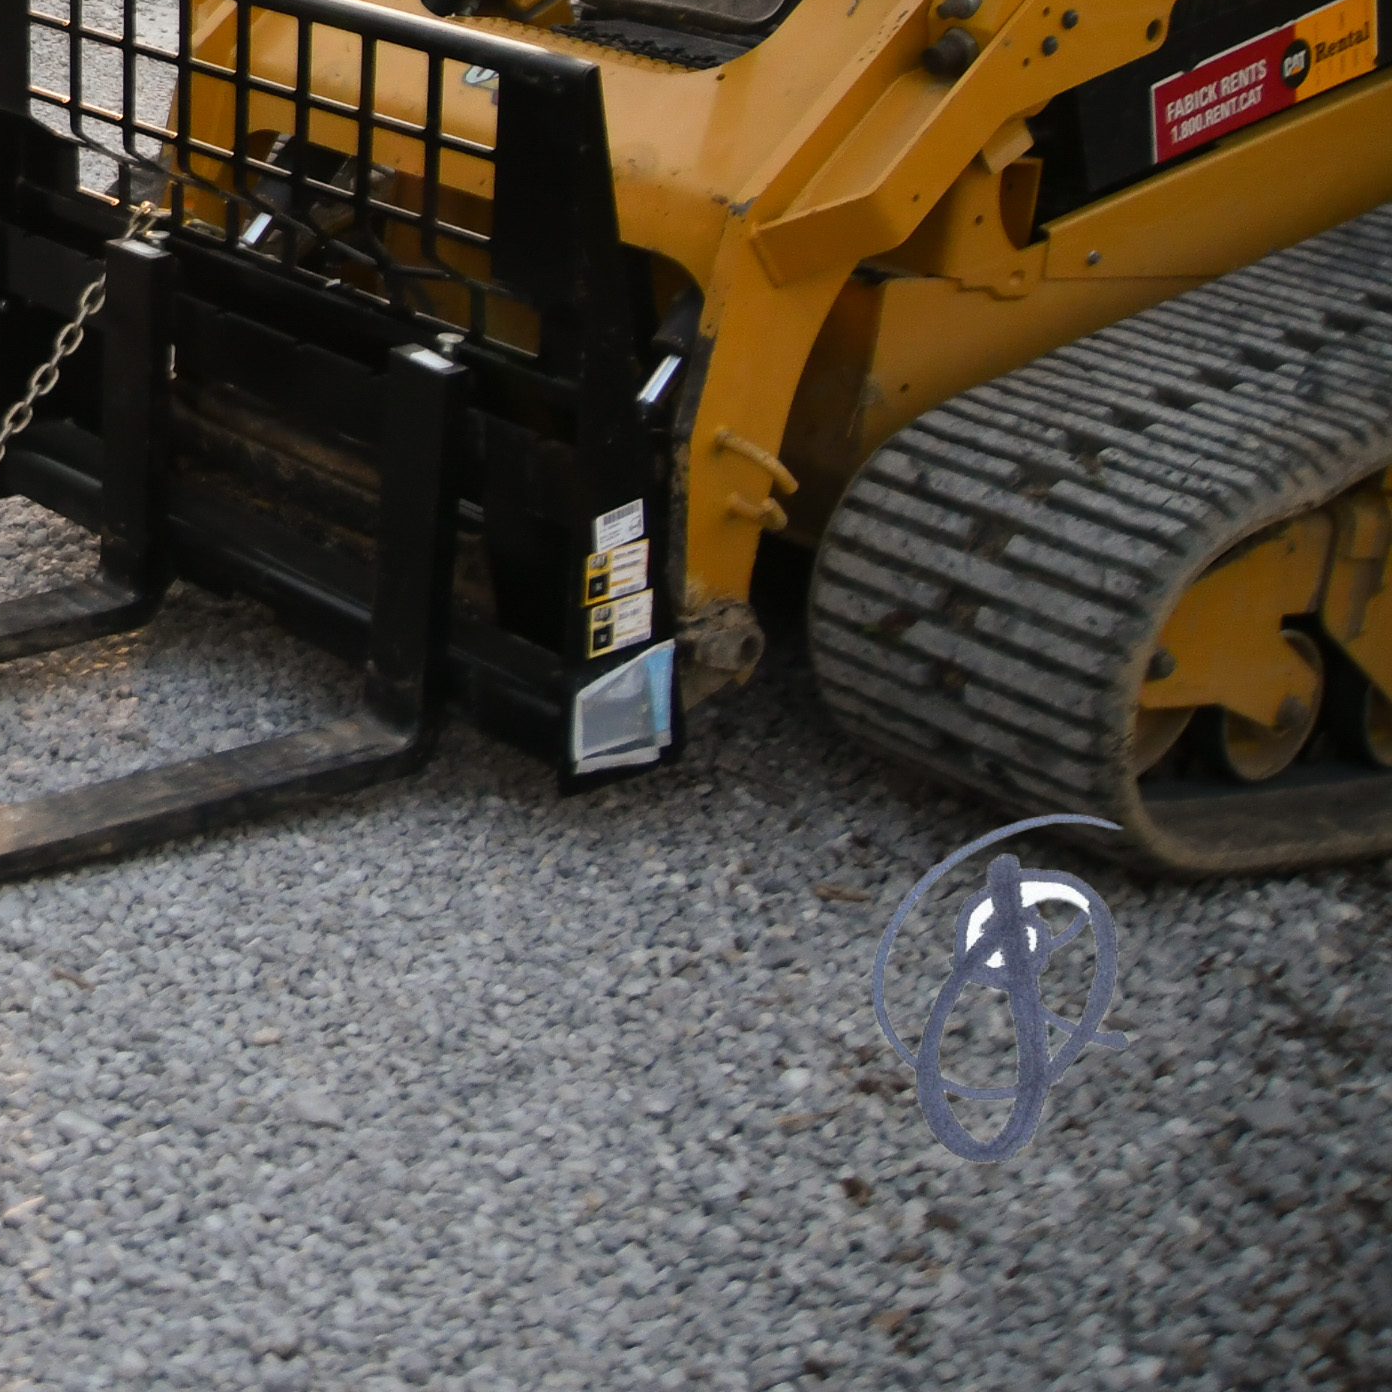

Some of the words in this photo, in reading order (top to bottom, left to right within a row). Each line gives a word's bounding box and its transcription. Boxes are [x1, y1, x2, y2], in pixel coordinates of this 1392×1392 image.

[1282, 49, 1307, 78] CAT
[1314, 21, 1370, 63] Rental
[1166, 81, 1219, 124] FABICK
[1220, 59, 1267, 93] RENTS
[1170, 85, 1263, 145] 1.800.RENT.CAT
